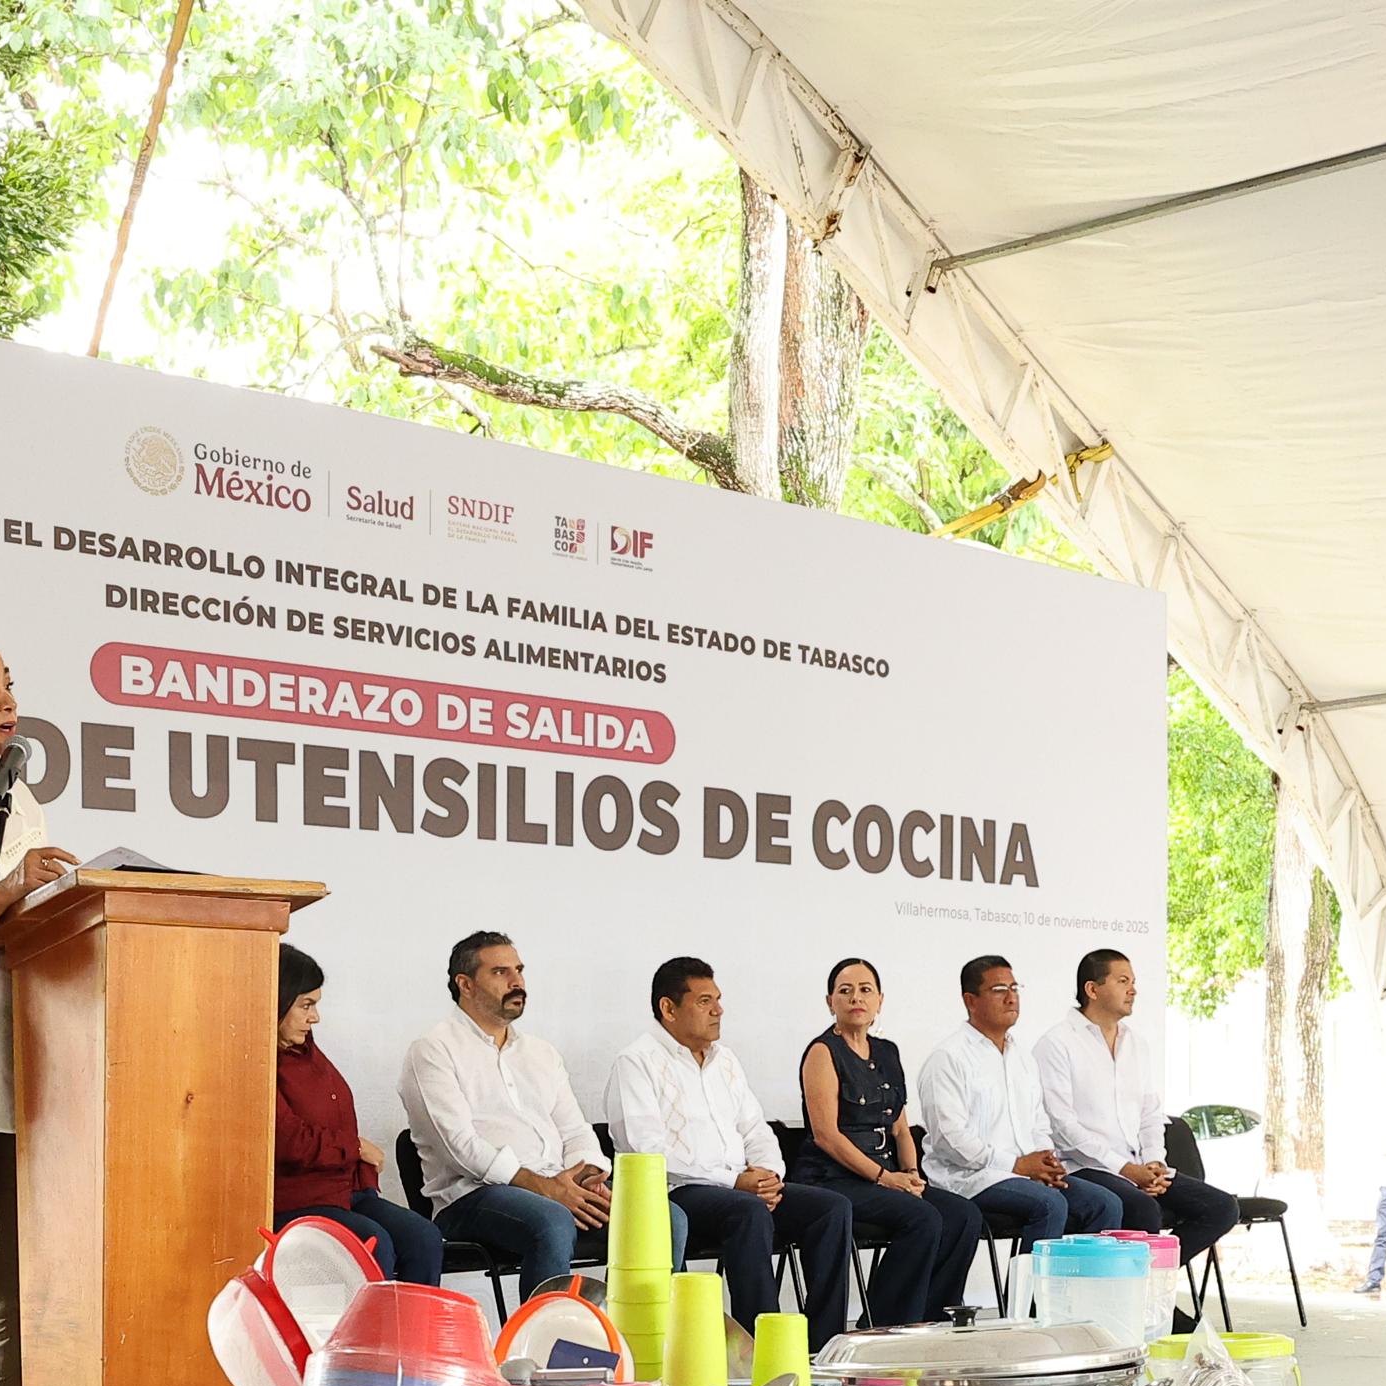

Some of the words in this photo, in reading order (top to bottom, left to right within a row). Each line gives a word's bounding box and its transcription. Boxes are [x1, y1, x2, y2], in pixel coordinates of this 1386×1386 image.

[194, 443, 285, 475] Gobierno
[291, 461, 312, 479] de
[194, 462, 312, 513] México
[346, 486, 414, 521] Salud
[447, 495, 515, 525] SNDIF
[4, 518, 42, 548] EL
[54, 526, 266, 580] DESARROLLO
[275, 559, 414, 603] INTEGRAL
[423, 582, 458, 610] DE
[466, 590, 499, 616] LA
[507, 597, 608, 633] FAMILIA
[616, 614, 660, 642] DEL
[667, 622, 756, 656] ESTADO
[763, 638, 792, 662] DE
[798, 643, 890, 678] TABASCO
[106, 583, 277, 630] DIRECCIÓN
[287, 608, 325, 636] DE
[333, 616, 476, 657] SERVICIOS
[483, 638, 667, 684] ALIMENTARIOS
[120, 655, 423, 726] BANDERAZO
[437, 693, 494, 736] DE
[505, 703, 655, 754] SALIDA
[168, 729, 681, 856] UTENSILIOS
[702, 786, 792, 866] DE
[812, 799, 1040, 888] COCINA
[894, 901, 972, 922] Villahermosa,
[1024, 911, 1035, 925] 10
[1037, 913, 1051, 927] de
[1053, 916, 1109, 931] noviembre
[1110, 919, 1124, 932] de
[1125, 920, 1150, 934] 2025
